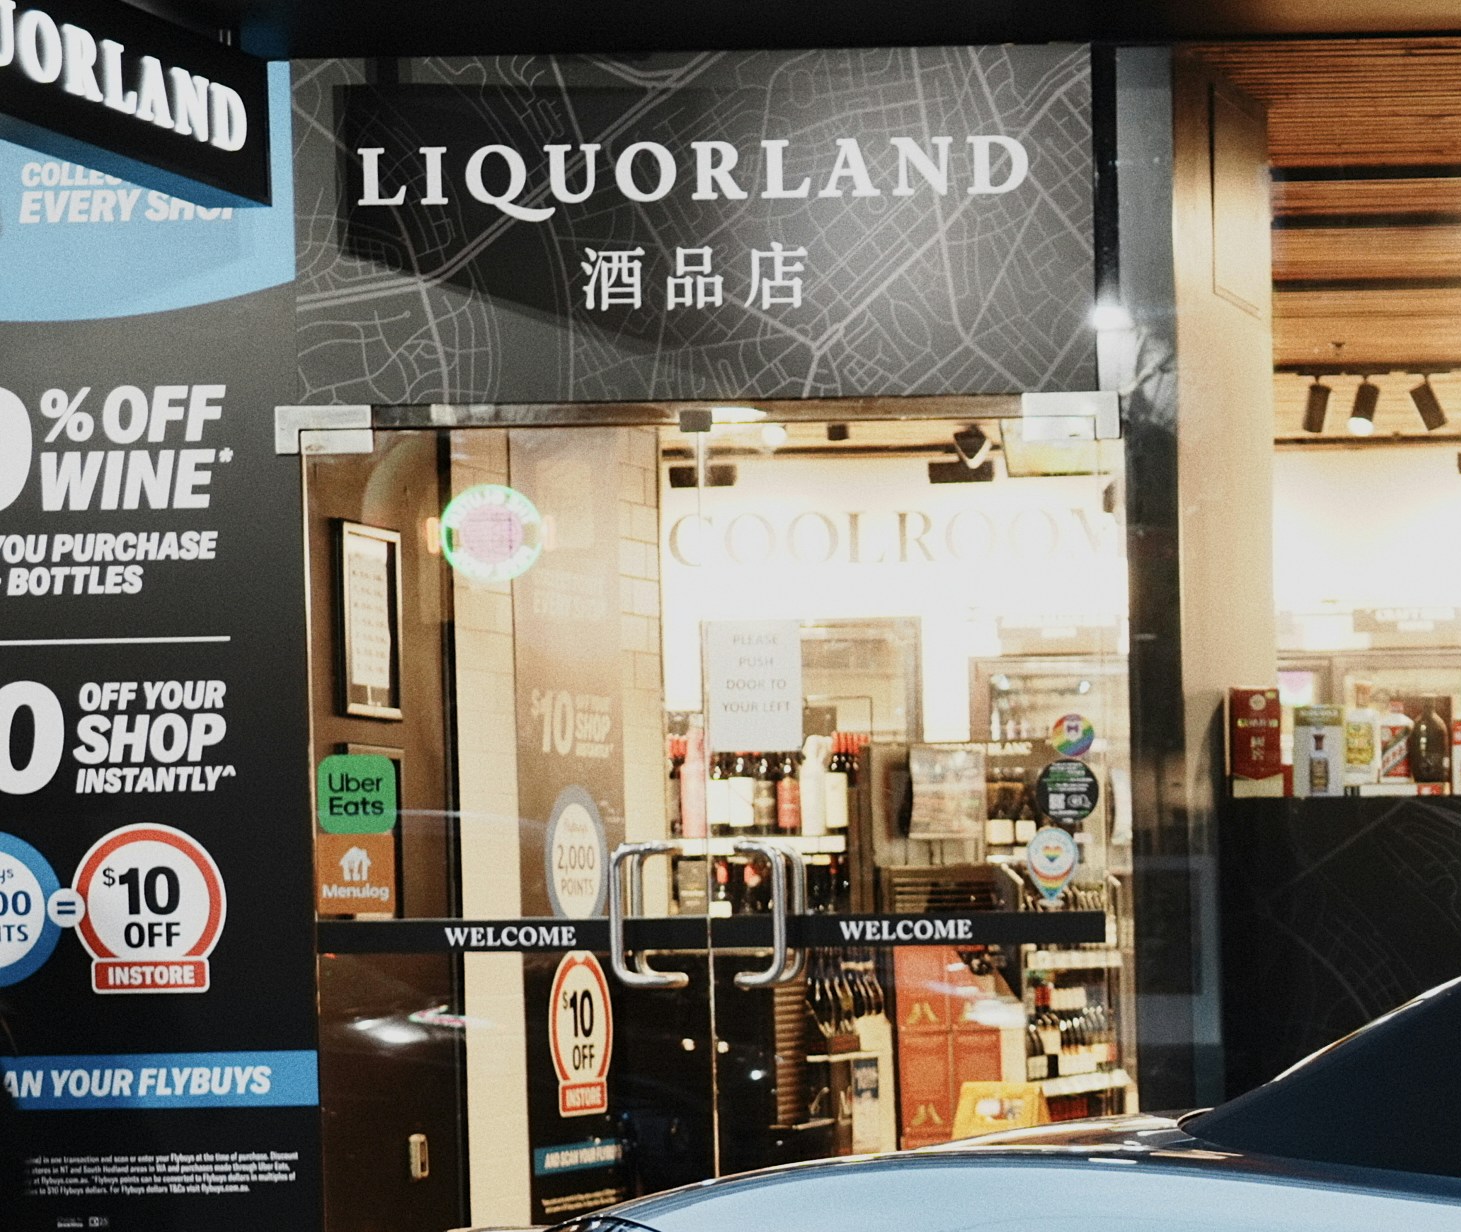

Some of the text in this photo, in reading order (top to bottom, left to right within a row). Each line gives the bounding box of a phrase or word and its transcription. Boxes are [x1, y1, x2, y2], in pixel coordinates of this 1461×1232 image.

[21, 162, 124, 187] COLLE
[357, 134, 1030, 223] LIQUORLAND
[19, 189, 142, 224] EVERY
[581, 241, 809, 312] 酒品店
[102, 384, 227, 444] OFF
[52, 531, 218, 561] PURCHASE
[7, 565, 144, 596] BOTTLES
[733, 634, 779, 646] PLEASE
[739, 657, 774, 667] PUSH
[79, 682, 137, 711] OFF
[143, 680, 227, 710] YOUR
[726, 679, 788, 690] DOOR TO
[722, 701, 790, 713] YOUR LEFT
[72, 713, 227, 765] SHOP
[328, 773, 383, 793] Uber
[328, 796, 385, 817] Eats
[557, 845, 594, 871] 2,000
[102, 866, 181, 916] $10
[322, 882, 390, 901] Menulog
[561, 878, 594, 897] POINTS
[124, 921, 181, 949] OFF
[444, 926, 577, 948] WELCOME
[839, 918, 973, 942] WELCOME
[107, 965, 196, 987] INSTORE
[562, 989, 594, 1039] $10
[572, 1045, 595, 1070] OFF
[51, 1068, 133, 1097] YOUR
[137, 1065, 272, 1096] FLYBUYS
